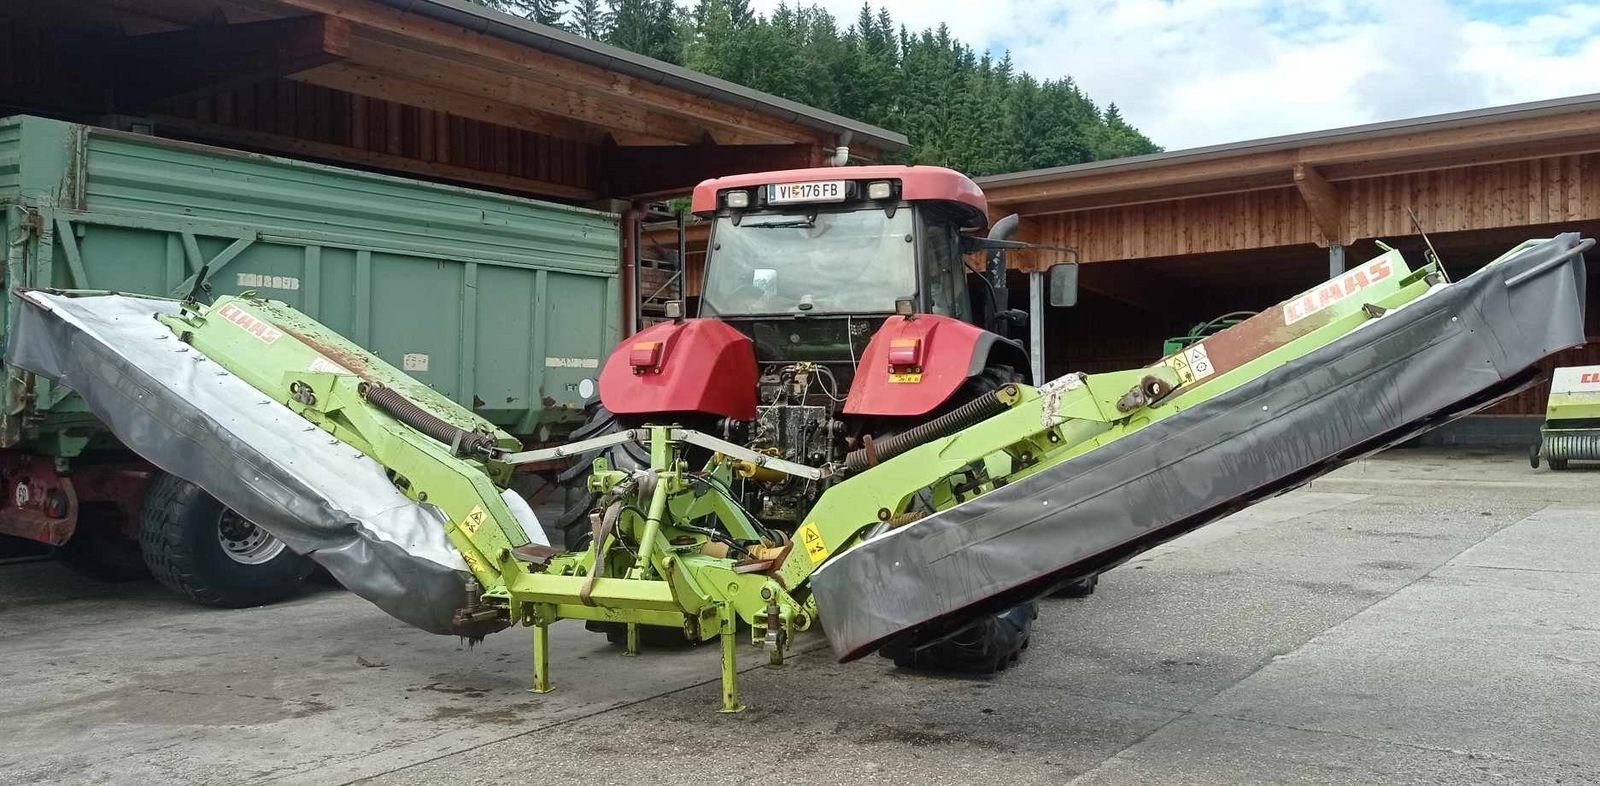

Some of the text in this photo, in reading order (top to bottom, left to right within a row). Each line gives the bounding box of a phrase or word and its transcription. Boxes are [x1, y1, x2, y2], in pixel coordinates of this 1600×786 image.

[780, 183, 838, 199] VI 176 FB
[1286, 259, 1391, 321] CLAAS
[219, 304, 280, 343] CLAAS
